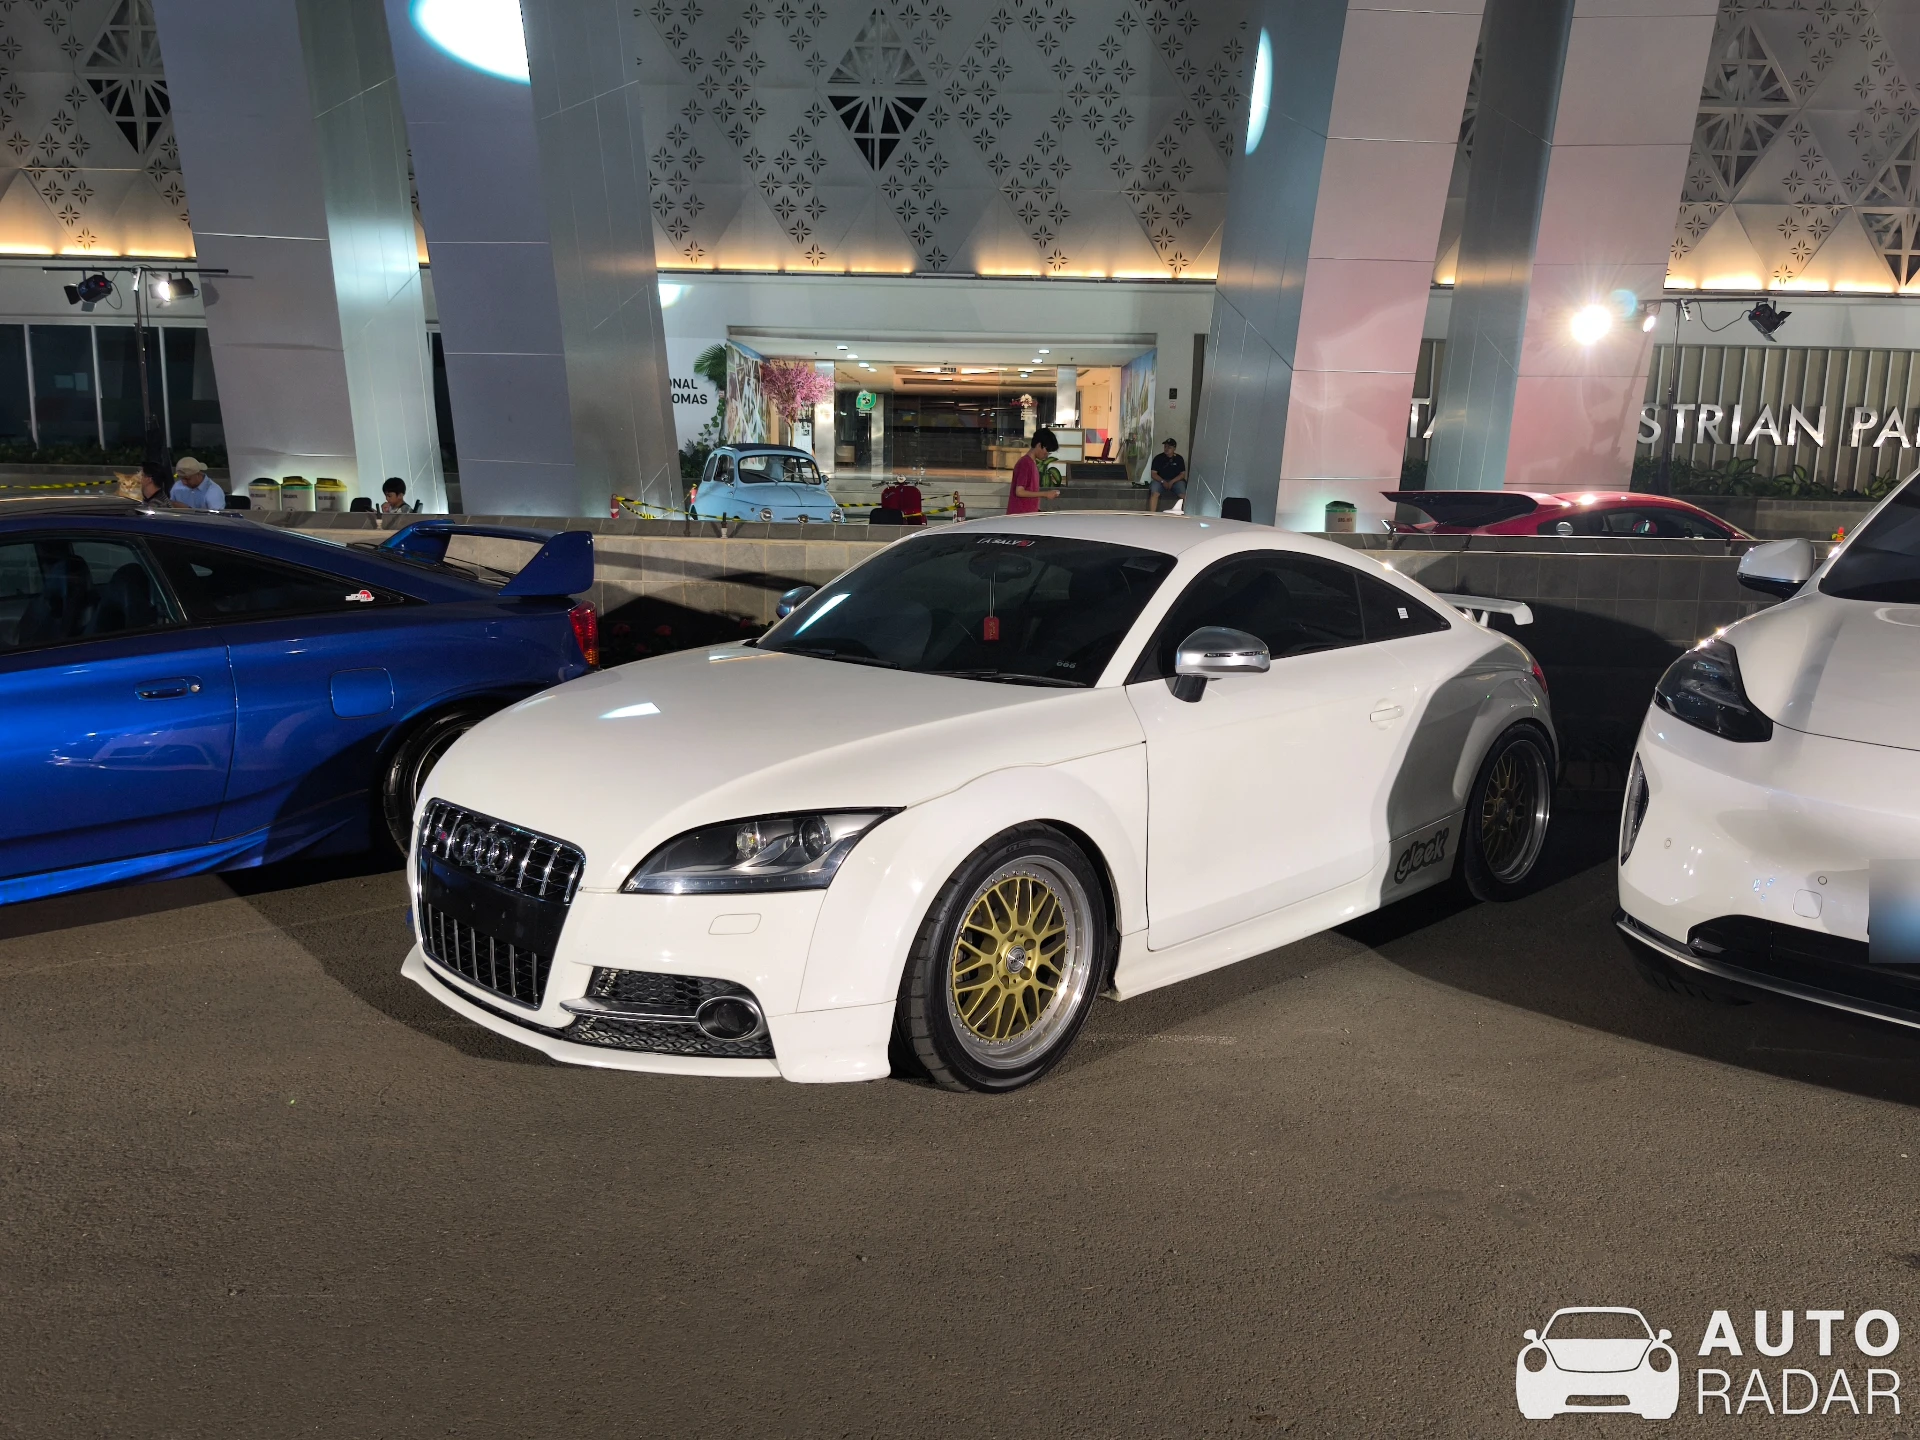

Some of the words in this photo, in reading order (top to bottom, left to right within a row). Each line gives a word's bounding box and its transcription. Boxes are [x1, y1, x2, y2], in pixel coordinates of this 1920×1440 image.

[670, 378, 698, 389] NAL
[1637, 402, 1827, 448] STRIAN
[1850, 405, 1920, 448] PA
